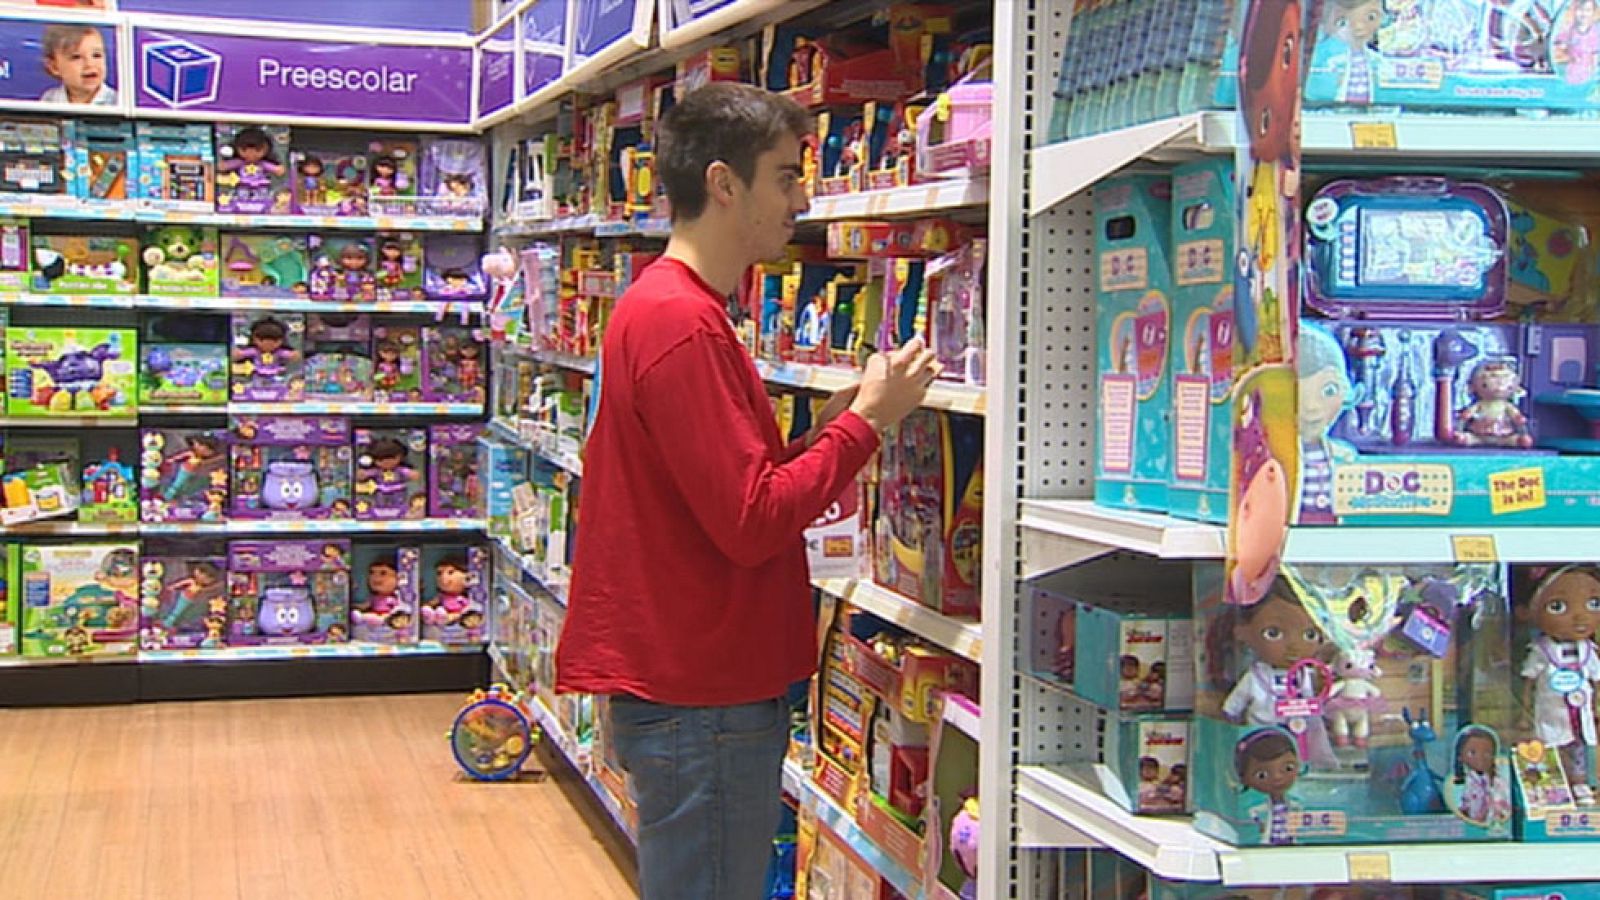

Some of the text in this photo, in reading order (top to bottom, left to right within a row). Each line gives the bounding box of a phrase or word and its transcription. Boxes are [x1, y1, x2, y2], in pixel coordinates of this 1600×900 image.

[259, 58, 418, 93] Preescolar
[1493, 476, 1540, 492] The Doc
[1502, 493, 1514, 504] is
